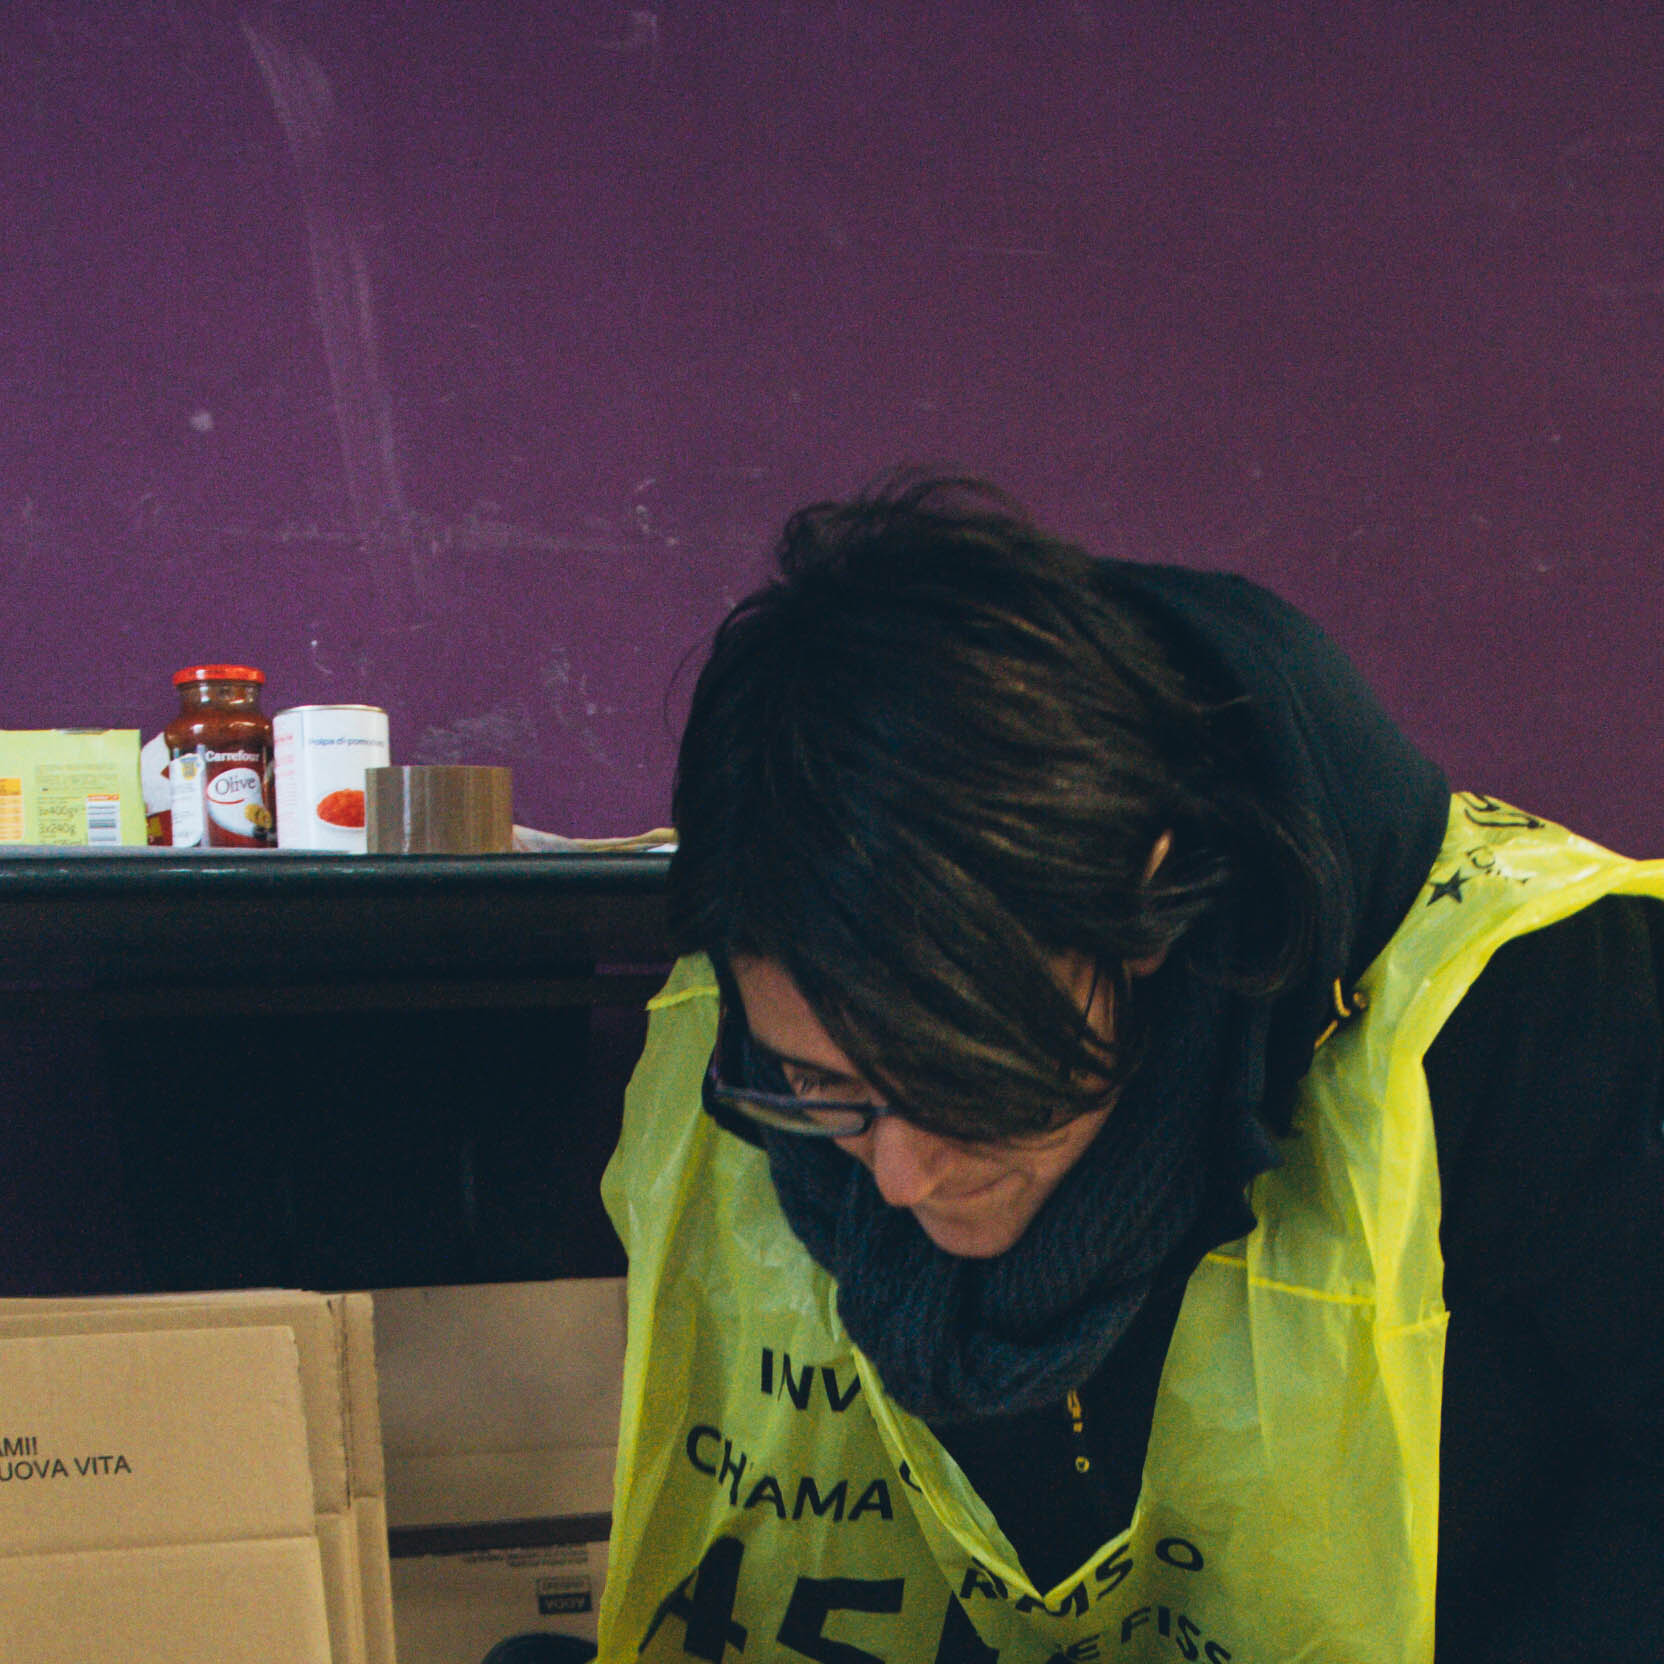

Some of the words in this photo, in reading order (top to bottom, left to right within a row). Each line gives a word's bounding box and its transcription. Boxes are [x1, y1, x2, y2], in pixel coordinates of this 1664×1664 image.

[205, 749, 260, 762] Carrefour
[215, 775, 257, 796] Olive
[74, 1454, 133, 1477] VITA
[686, 1424, 894, 1522] CHAMA
